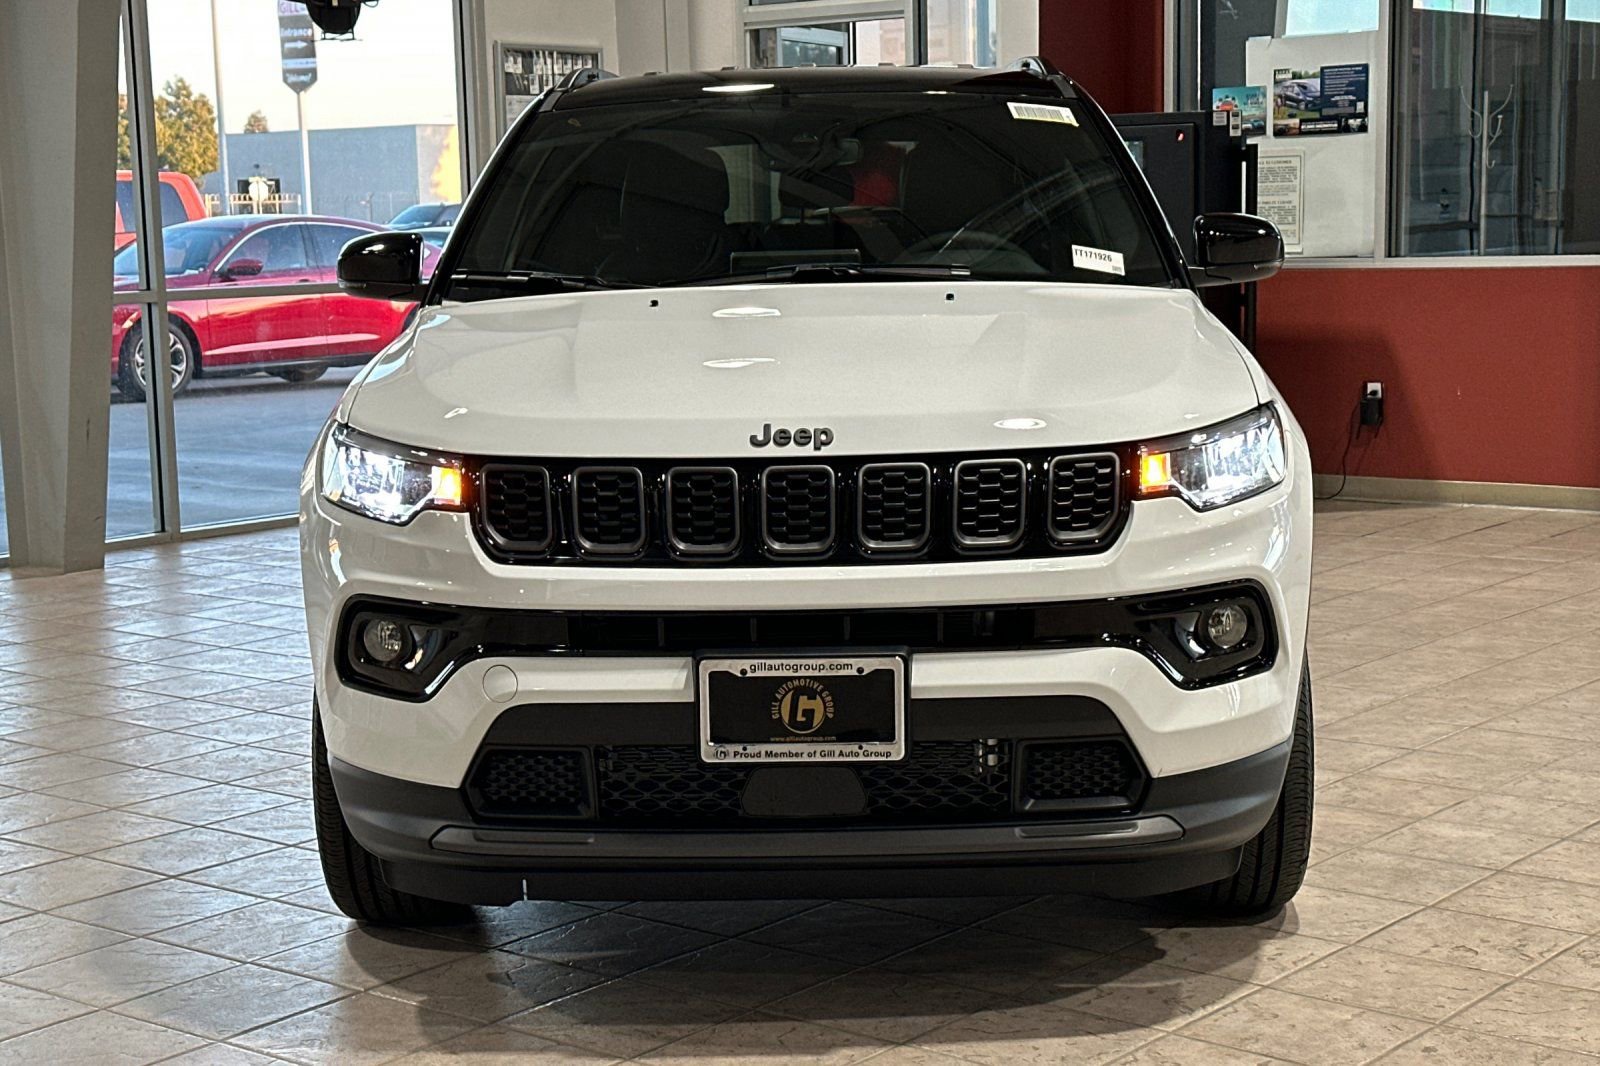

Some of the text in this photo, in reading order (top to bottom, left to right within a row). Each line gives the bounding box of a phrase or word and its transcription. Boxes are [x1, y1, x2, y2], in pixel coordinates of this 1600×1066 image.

[750, 423, 834, 451] Jeep
[749, 662, 853, 673] gillautogroup.com
[771, 679, 835, 719] GILL AUTOMOTIVE GROUP
[764, 750, 804, 758] Member
[807, 750, 817, 758] of
[819, 750, 835, 758] Gill
[862, 749, 892, 759] Group
